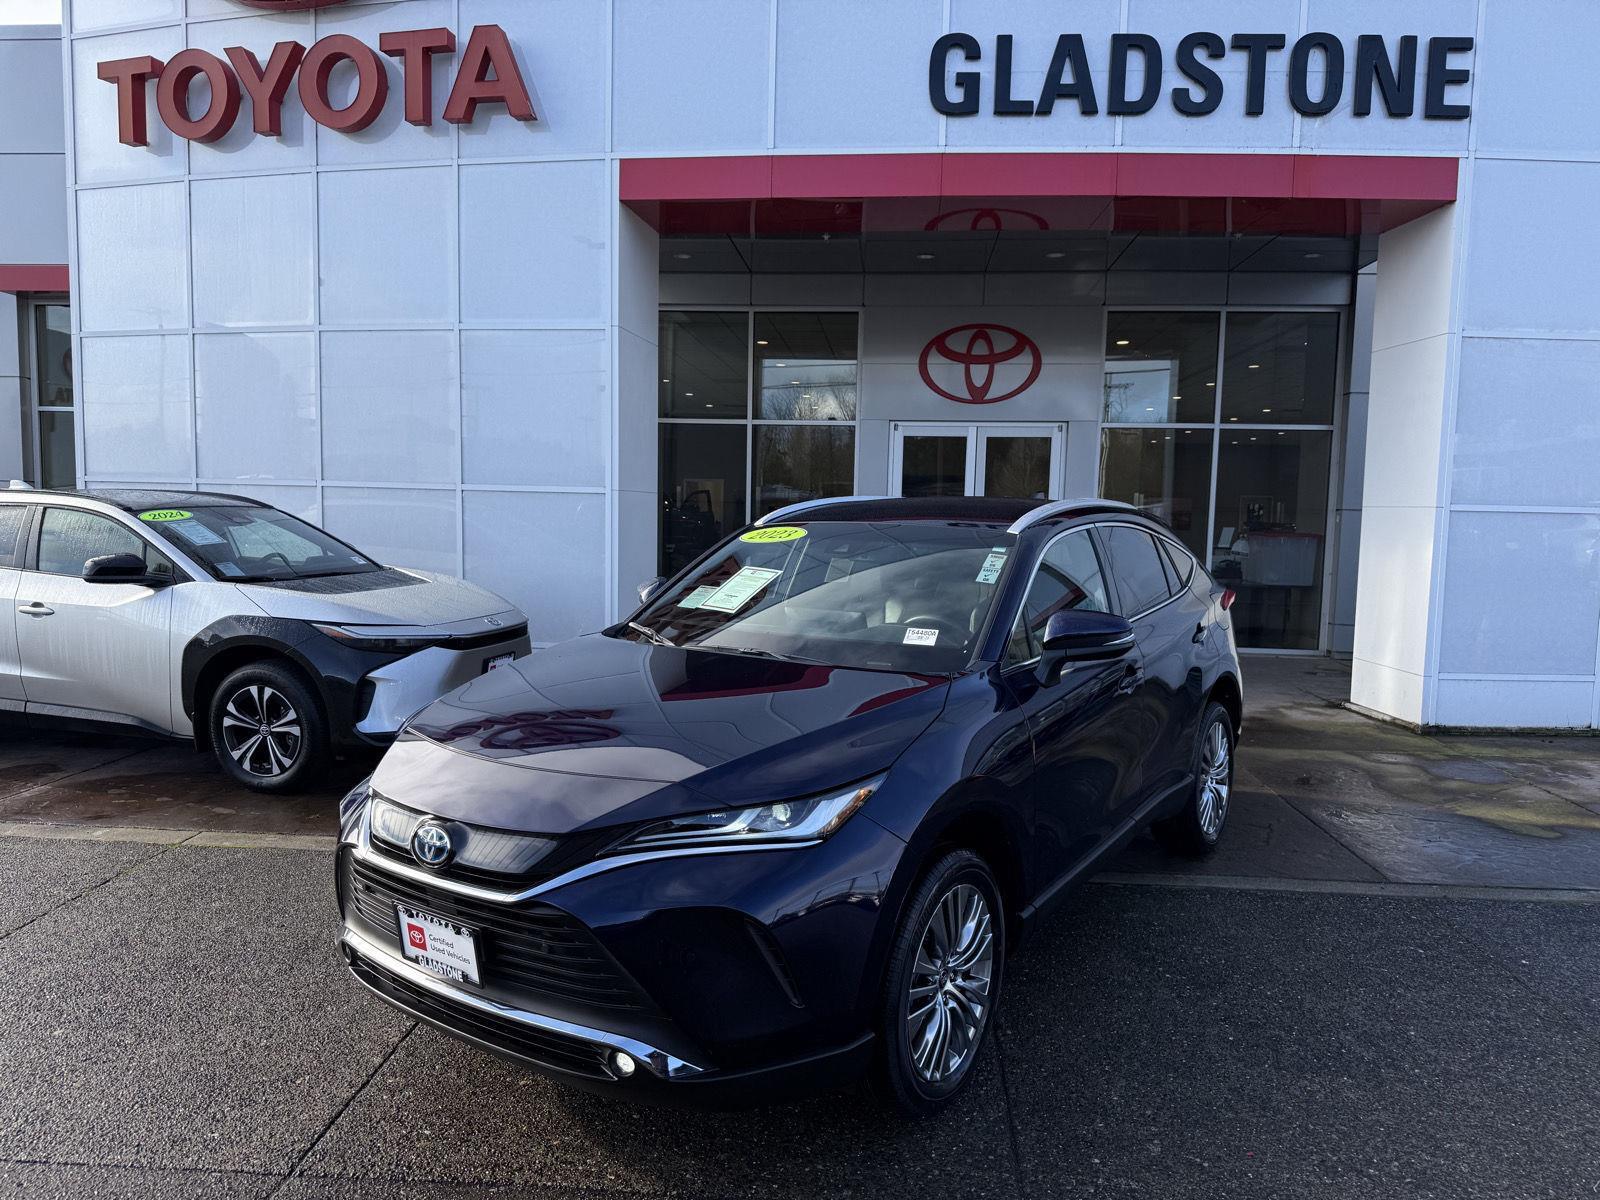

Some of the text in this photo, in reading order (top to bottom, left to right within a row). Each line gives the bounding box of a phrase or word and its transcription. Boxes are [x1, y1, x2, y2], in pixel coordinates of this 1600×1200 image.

[97, 24, 537, 147] TOYOTA
[929, 31, 1475, 119] GLADSTONE
[148, 511, 185, 520] 2024
[747, 529, 799, 540] 2023
[413, 910, 457, 933] TOYOTA
[428, 934, 454, 949] Certified
[430, 944, 470, 964] Used Vehicles
[419, 956, 464, 983] GLADSTONE
